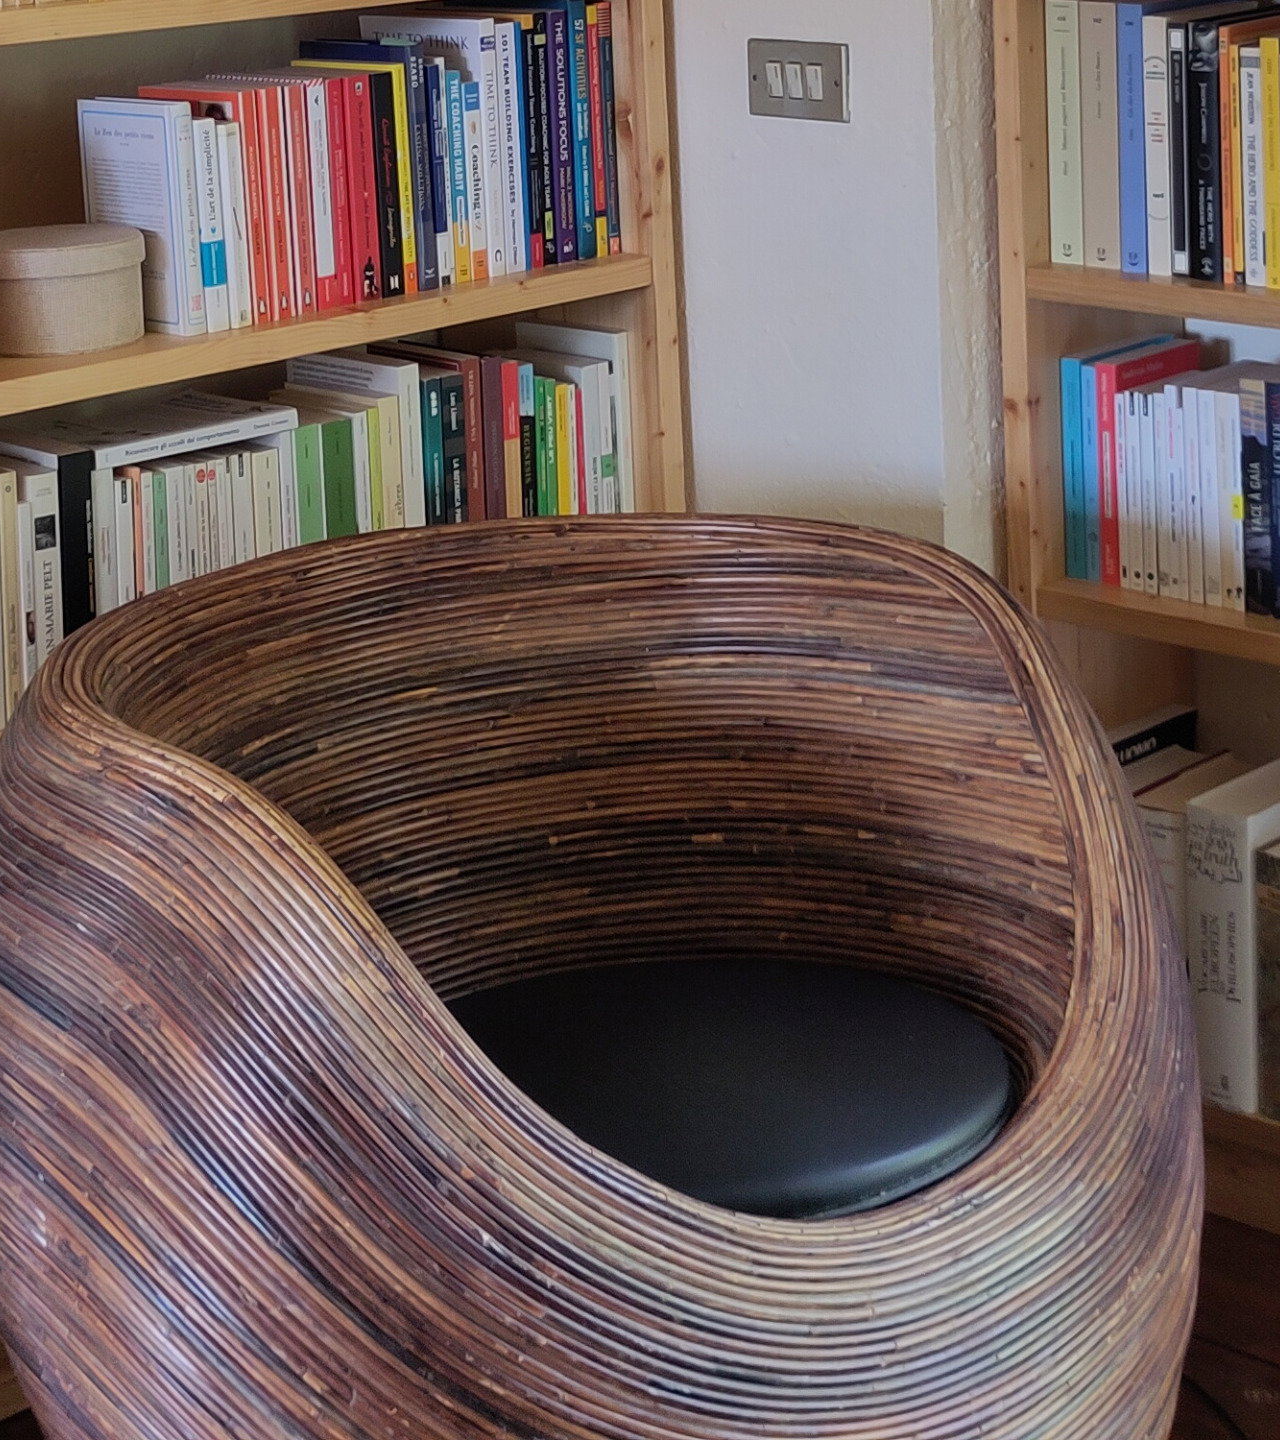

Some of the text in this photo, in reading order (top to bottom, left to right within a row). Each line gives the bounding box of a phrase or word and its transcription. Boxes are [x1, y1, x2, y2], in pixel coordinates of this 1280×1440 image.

[449, 78, 464, 191] THE COACHING HABIT
[501, 33, 516, 204] 101 TEAM BUILDING EXERCISES
[554, 19, 569, 161] THE SOLUTIONS FOCUS
[1247, 134, 1259, 263] THE HERO AND THE GODDESS
